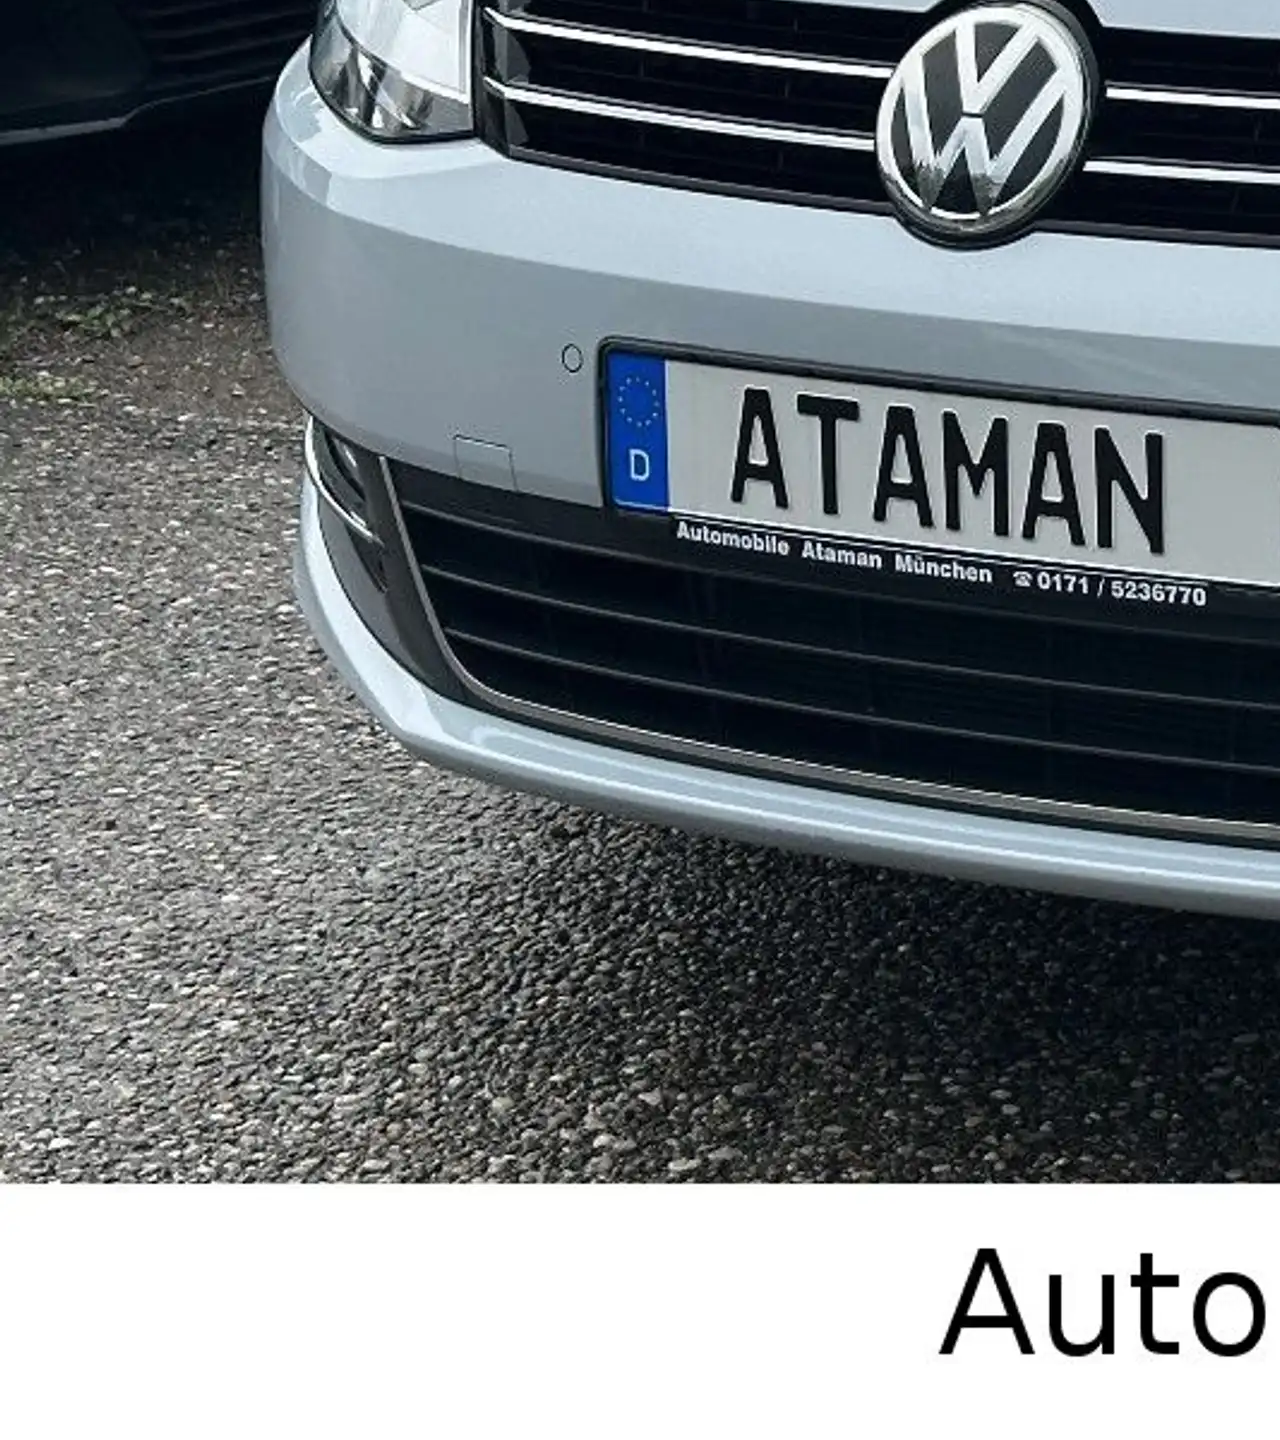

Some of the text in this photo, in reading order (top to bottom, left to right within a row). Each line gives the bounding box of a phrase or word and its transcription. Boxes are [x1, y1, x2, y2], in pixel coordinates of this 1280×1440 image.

[629, 448, 650, 482] D
[730, 386, 1166, 556] ATAMAN
[676, 520, 790, 557] Automobile
[801, 539, 883, 571] Ataman
[894, 552, 993, 584] München
[1036, 571, 1090, 596] 0171
[1110, 580, 1207, 607] 5236770
